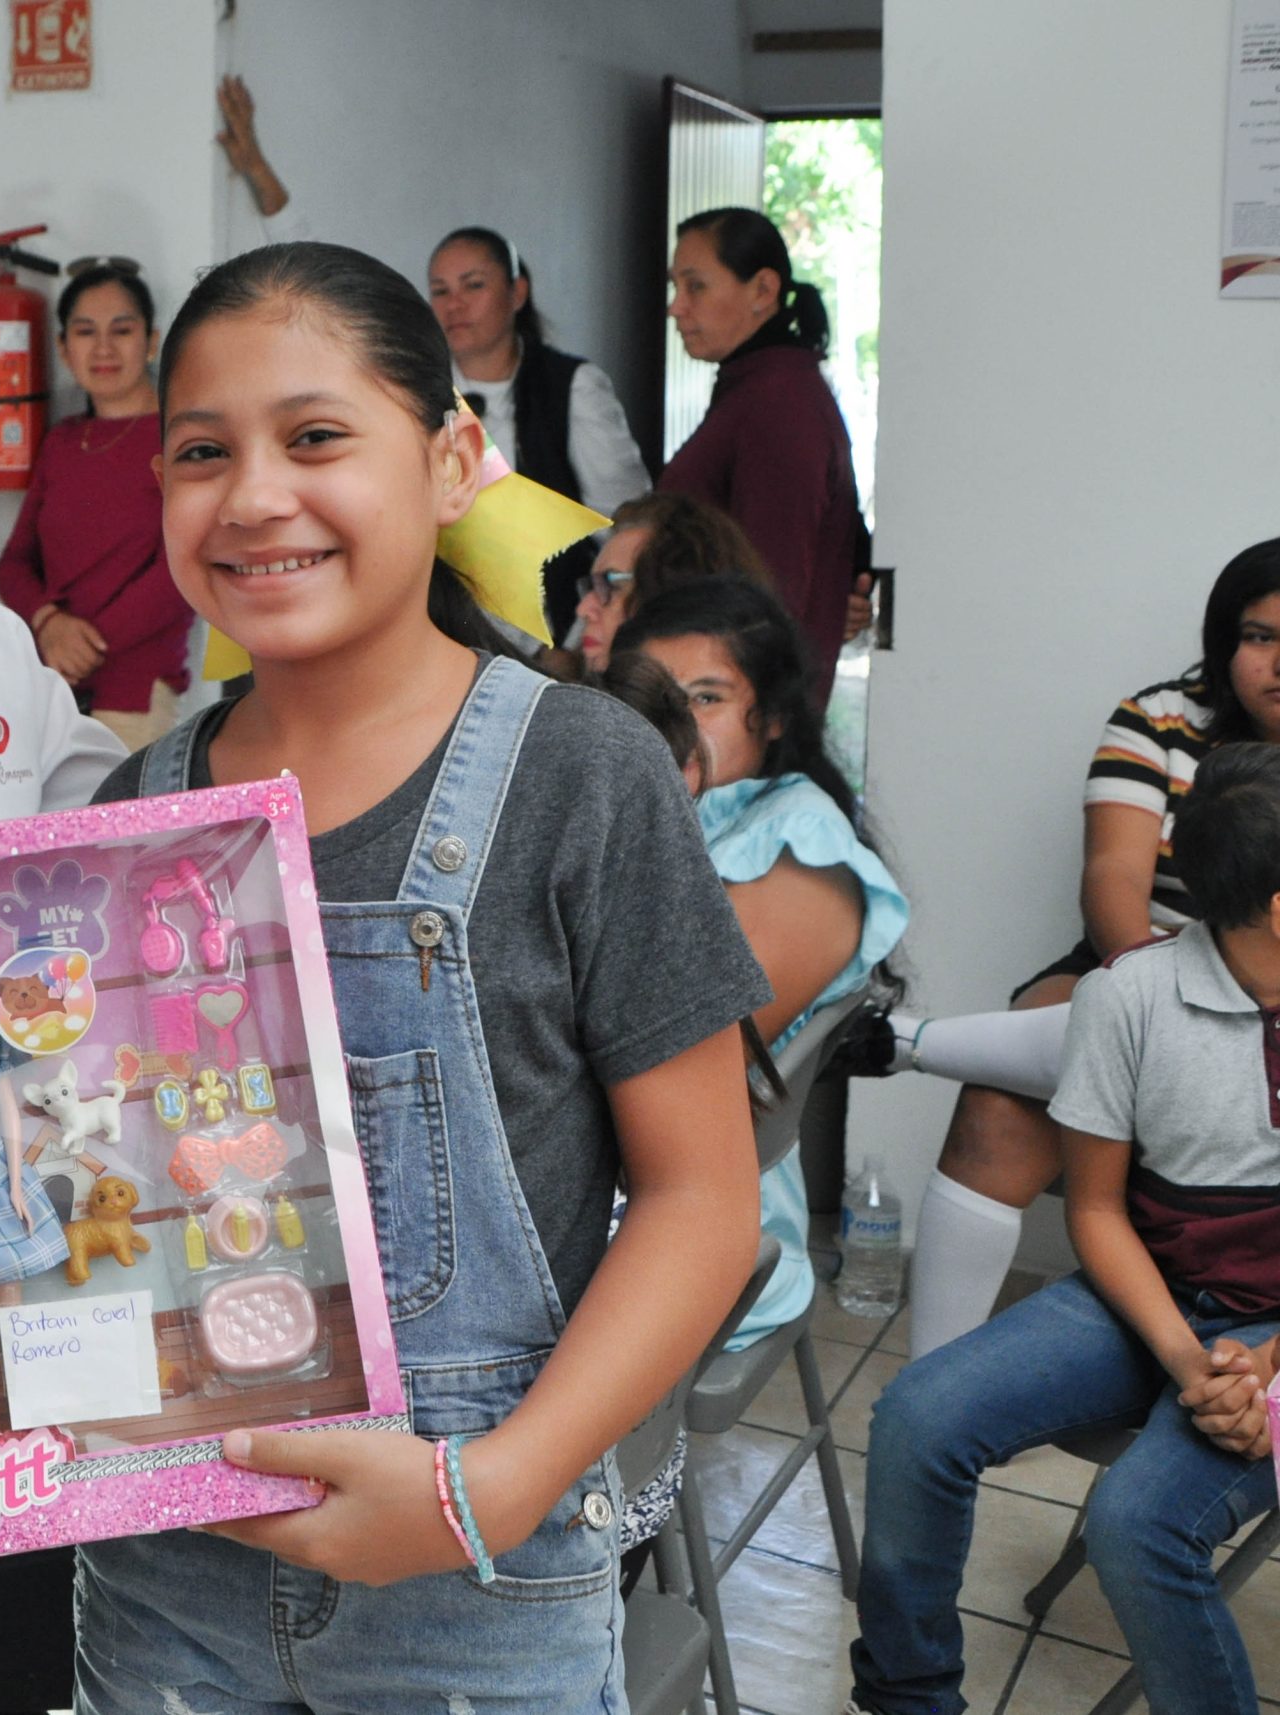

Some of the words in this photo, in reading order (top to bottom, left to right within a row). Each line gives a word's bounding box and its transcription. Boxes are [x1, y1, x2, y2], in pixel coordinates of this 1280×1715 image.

[268, 801, 290, 817] 3+
[39, 904, 70, 926] MY
[9, 1311, 77, 1337] Britani
[10, 1336, 81, 1365] Romero
